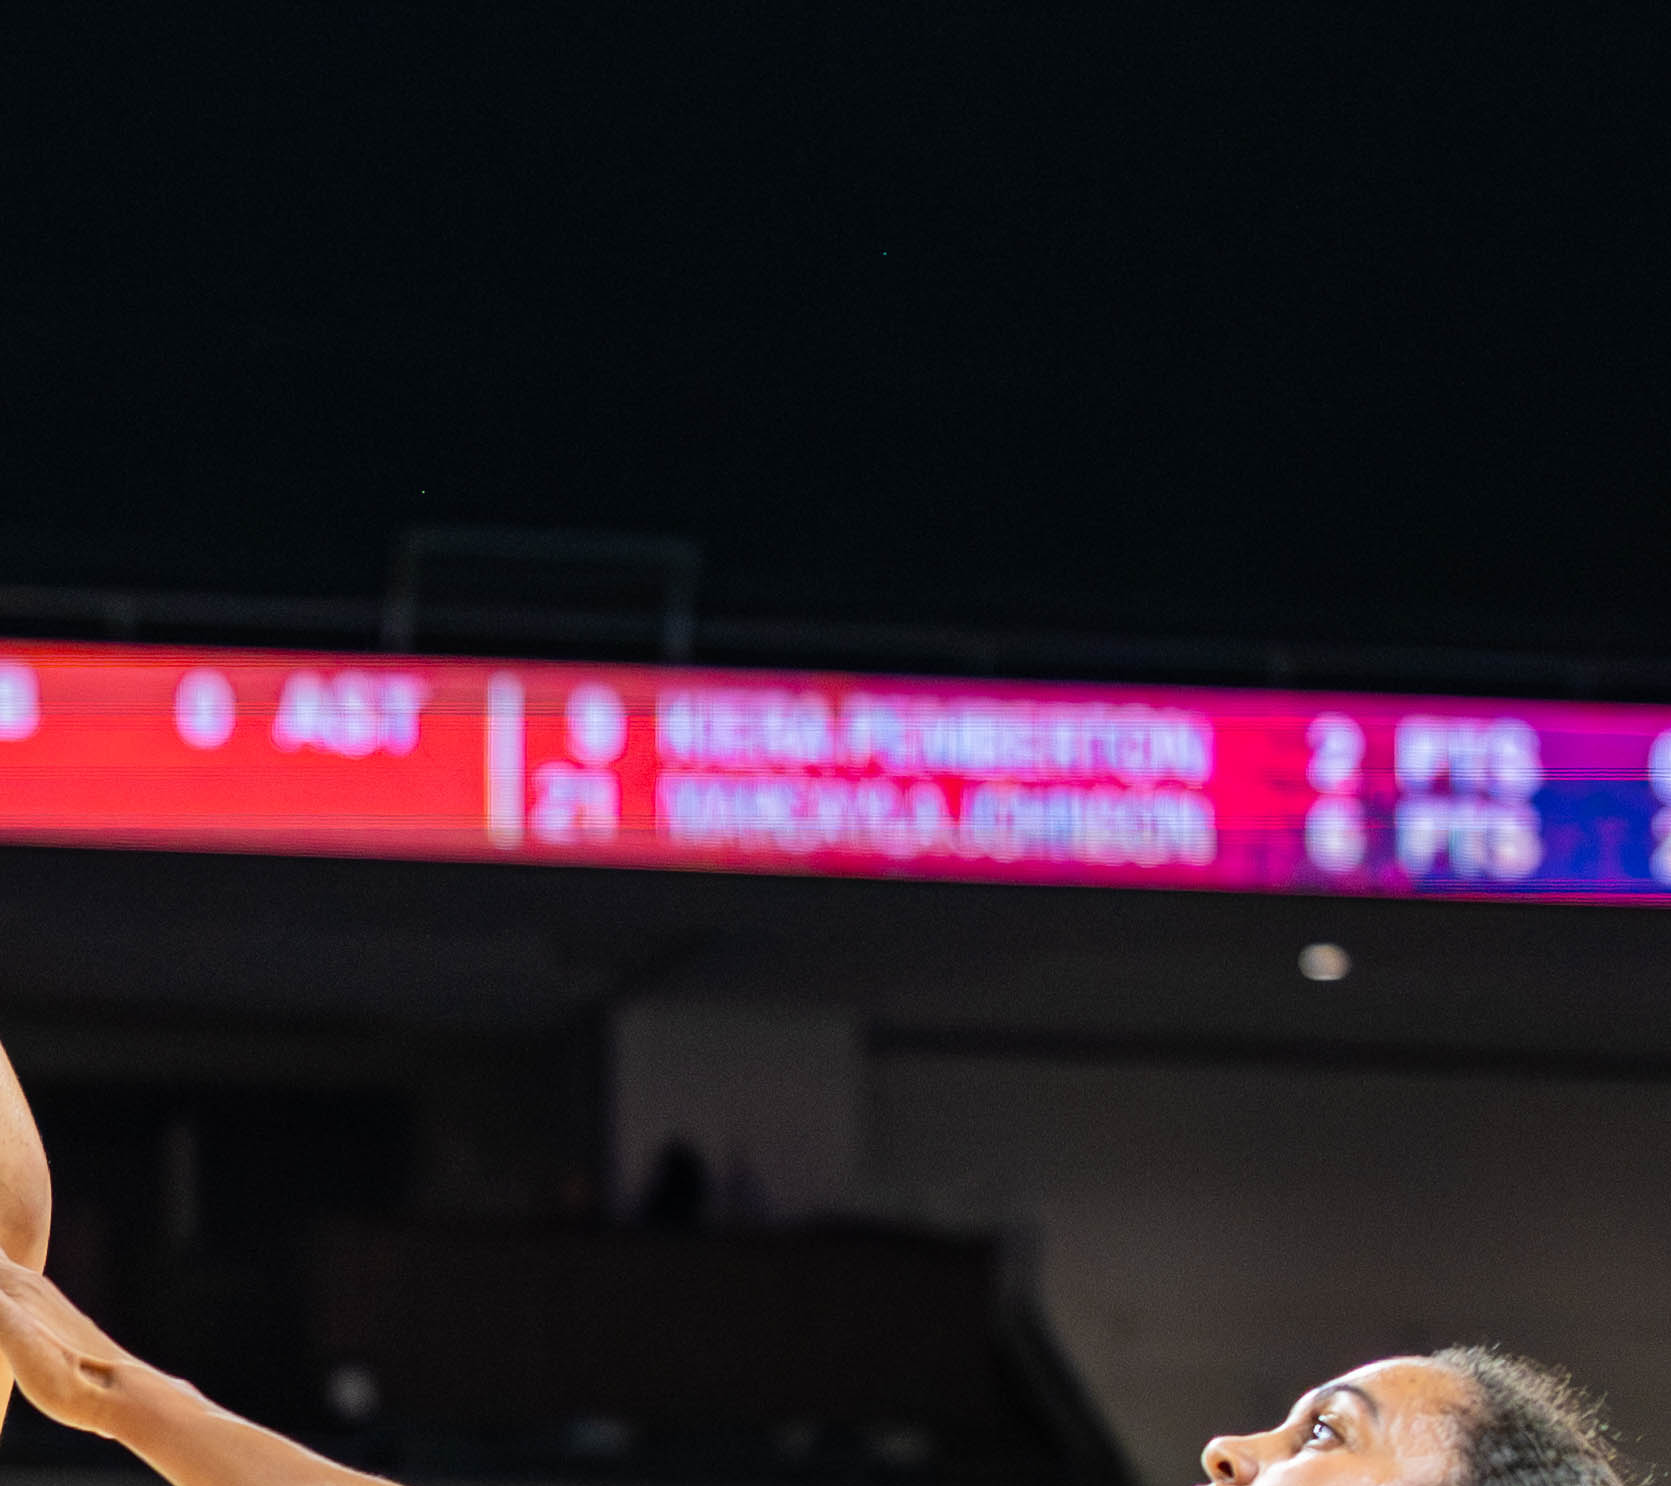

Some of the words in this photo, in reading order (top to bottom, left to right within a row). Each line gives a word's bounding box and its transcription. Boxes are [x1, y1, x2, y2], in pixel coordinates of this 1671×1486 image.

[175, 667, 236, 749] 0
[270, 669, 429, 758] AST
[1393, 716, 1541, 799] PTS
[1395, 799, 1541, 882] PTS
